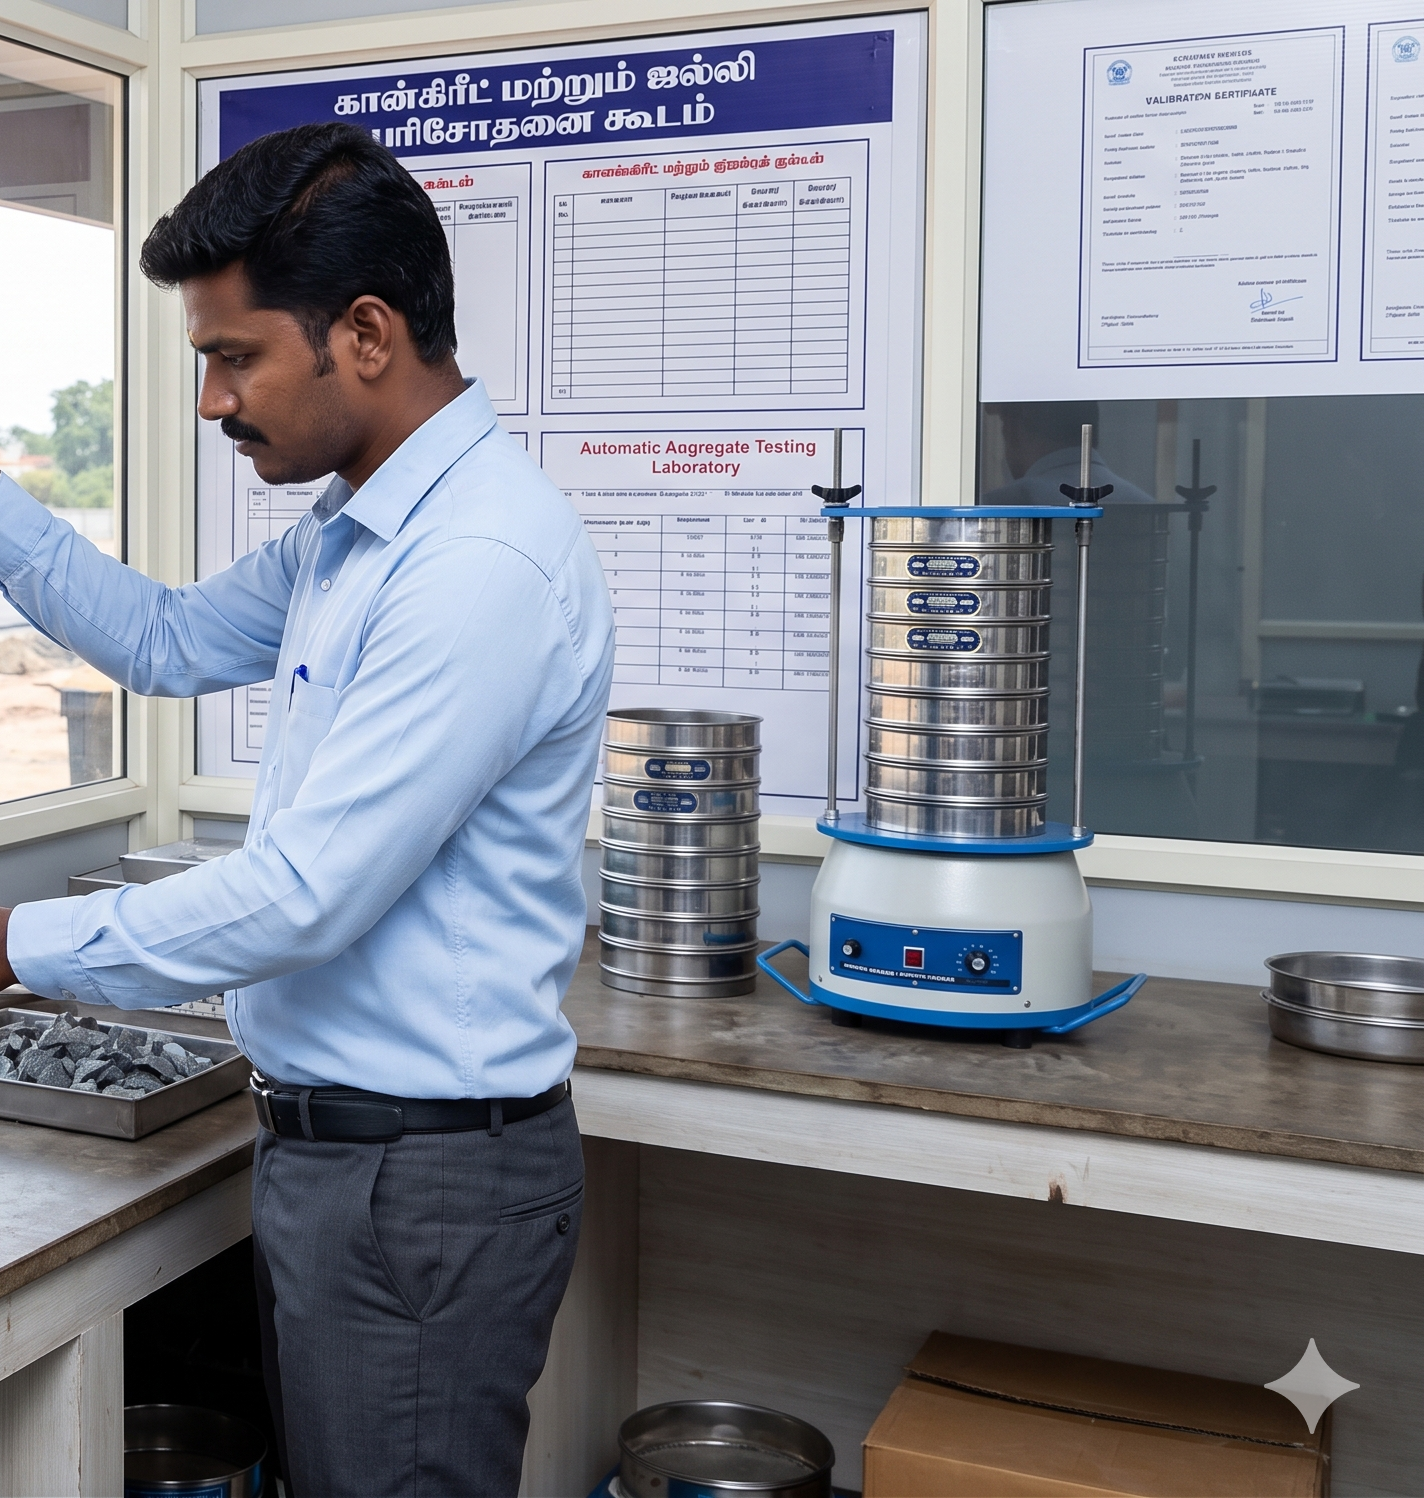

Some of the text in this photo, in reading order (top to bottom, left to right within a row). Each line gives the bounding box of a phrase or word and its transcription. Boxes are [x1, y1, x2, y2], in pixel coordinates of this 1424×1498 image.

[333, 49, 756, 117] கான்கிரீட் மற்றும் ஜல்லி
[603, 93, 716, 132] கூடம்
[579, 440, 662, 455] Automatic
[754, 439, 817, 457] Testing
[651, 460, 741, 477] Laboratory
